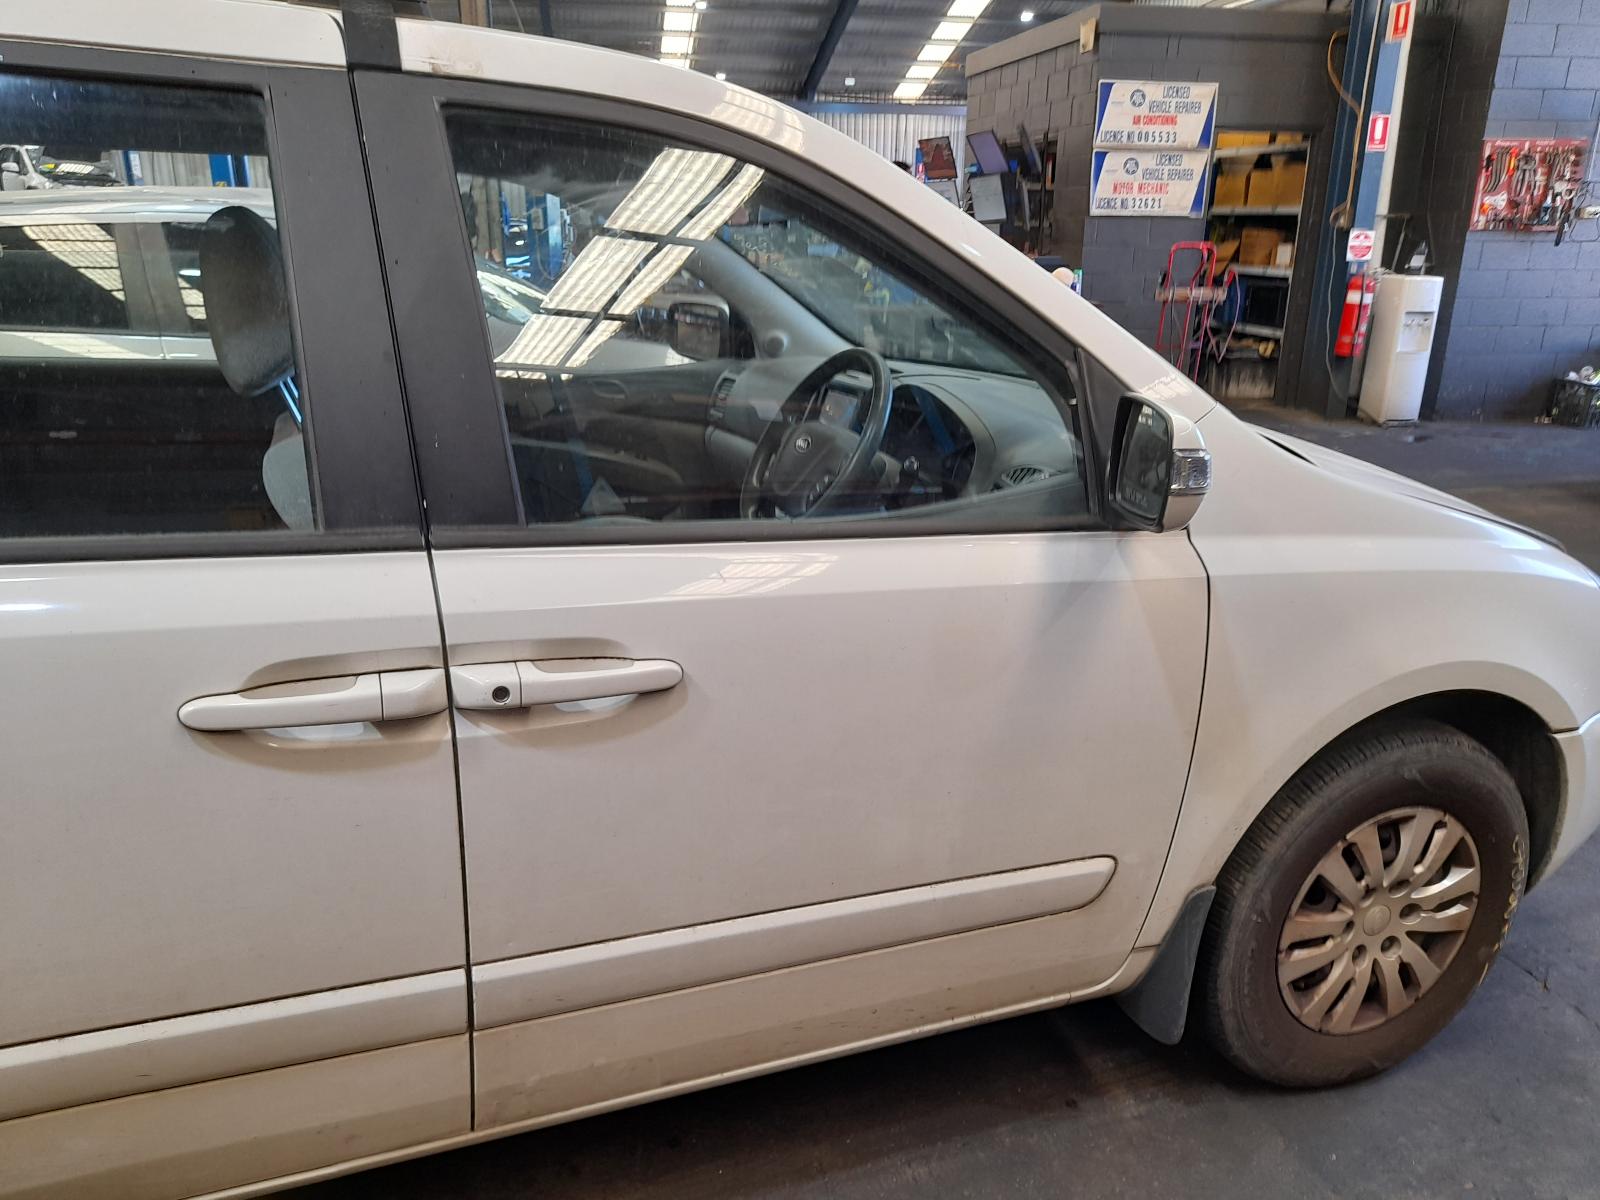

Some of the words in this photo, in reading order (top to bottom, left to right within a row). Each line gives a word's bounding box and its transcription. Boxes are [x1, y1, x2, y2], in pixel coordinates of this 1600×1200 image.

[1162, 86, 1191, 99] LICENSED
[1148, 101, 1173, 114] VEHICLE
[1174, 101, 1202, 114] REPAIRER
[1132, 115, 1141, 126] AIR
[1142, 115, 1178, 126] CONDITIONING
[1137, 130, 1178, 143] 005533
[1155, 154, 1184, 167] LICENSED
[1141, 168, 1166, 181] VEHICLE
[1167, 169, 1195, 182] REPAIRER
[1112, 182, 1134, 195] MOTOR
[1137, 183, 1170, 196] MECHANIC
[1131, 198, 1163, 210] 32621
